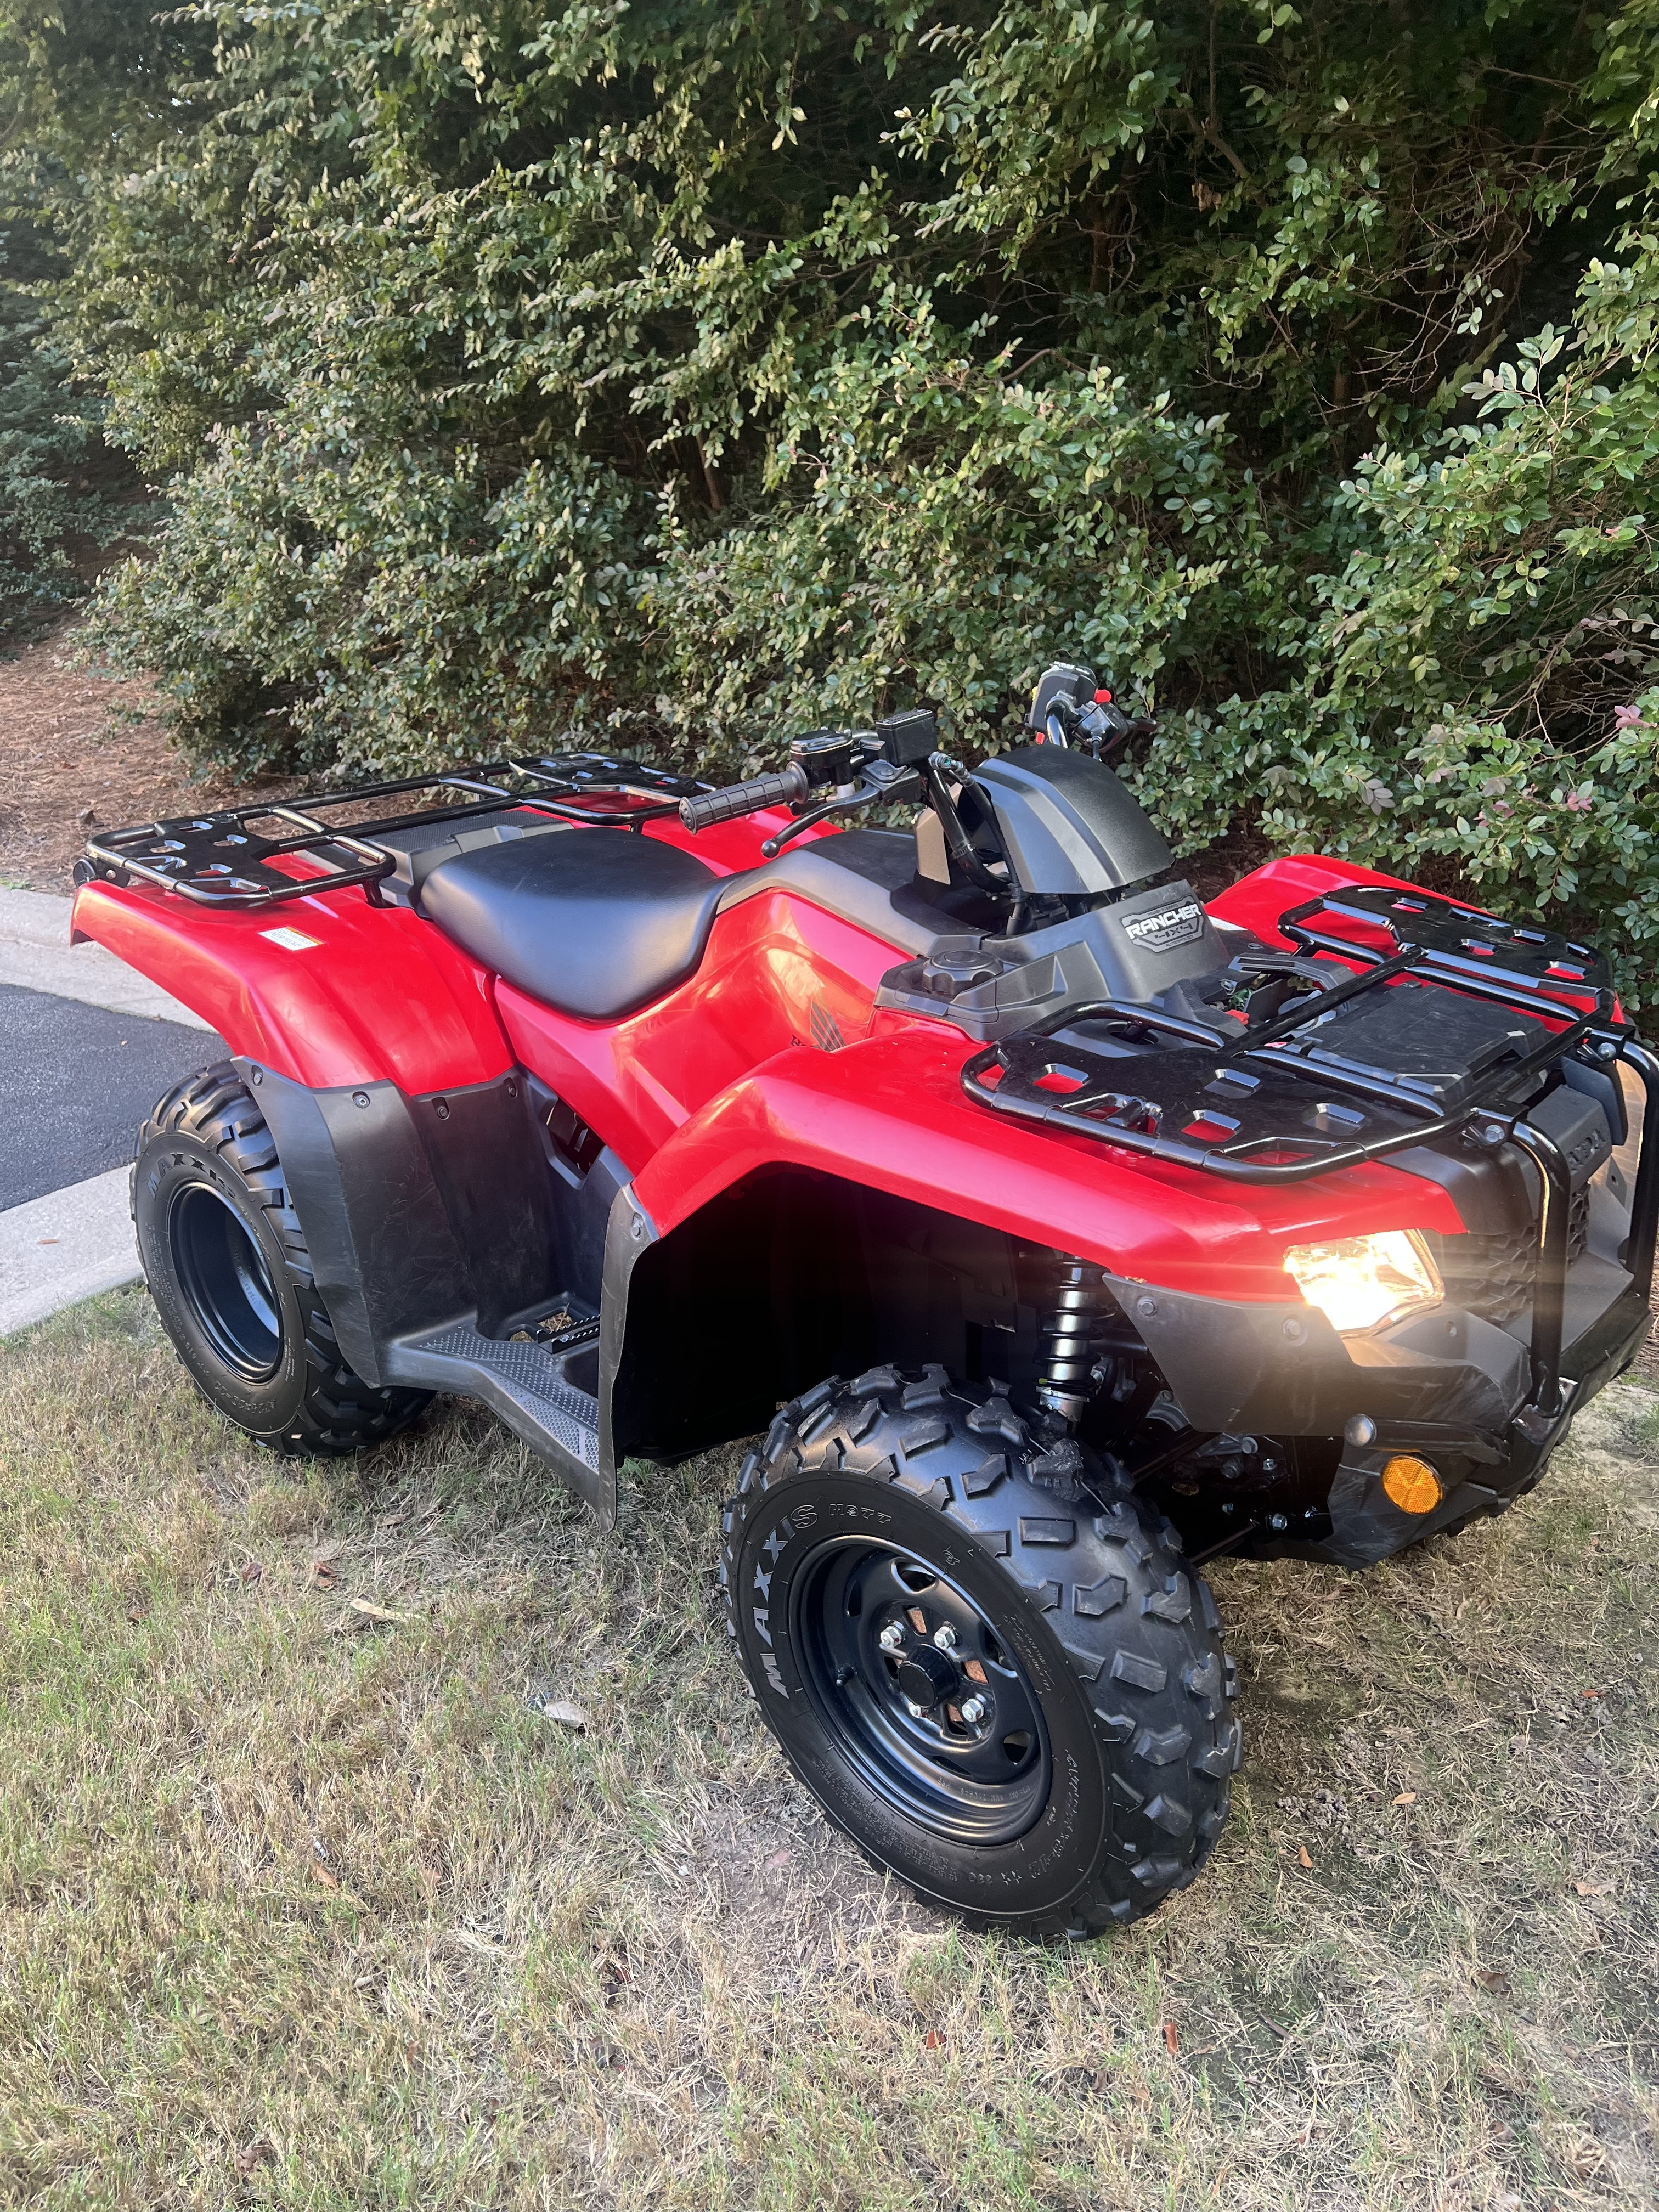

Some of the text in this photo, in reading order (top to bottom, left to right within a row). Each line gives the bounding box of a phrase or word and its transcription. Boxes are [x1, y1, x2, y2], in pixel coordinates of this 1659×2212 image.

[1125, 904, 1201, 939] RANCHER
[147, 1152, 236, 1202] MAXXIS
[752, 1504, 818, 1699] MAXXIS
